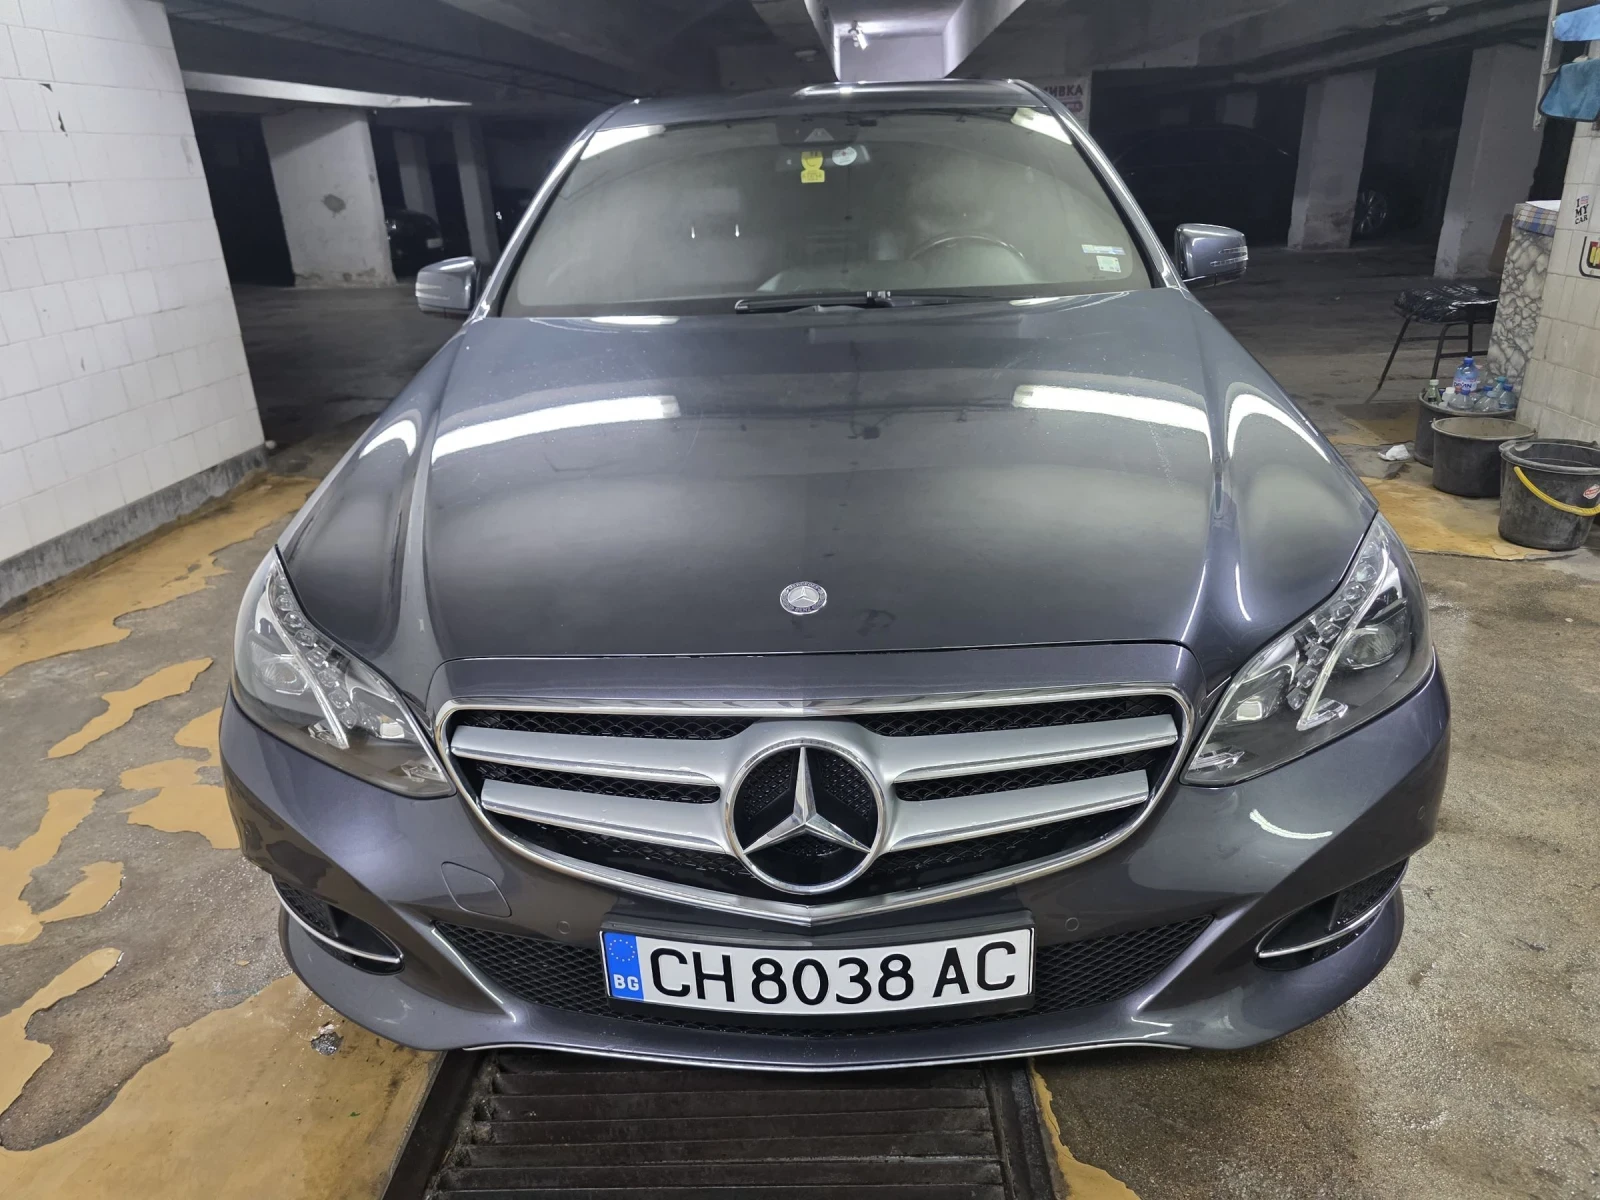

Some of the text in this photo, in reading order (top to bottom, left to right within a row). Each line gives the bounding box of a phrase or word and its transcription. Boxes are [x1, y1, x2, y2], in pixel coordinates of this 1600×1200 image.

[1043, 84, 1083, 97] ИВКА
[1575, 204, 1589, 218] MY
[1575, 215, 1588, 224] CAR
[649, 941, 1016, 1006] CH 8038 AC
[613, 974, 640, 991] BG
